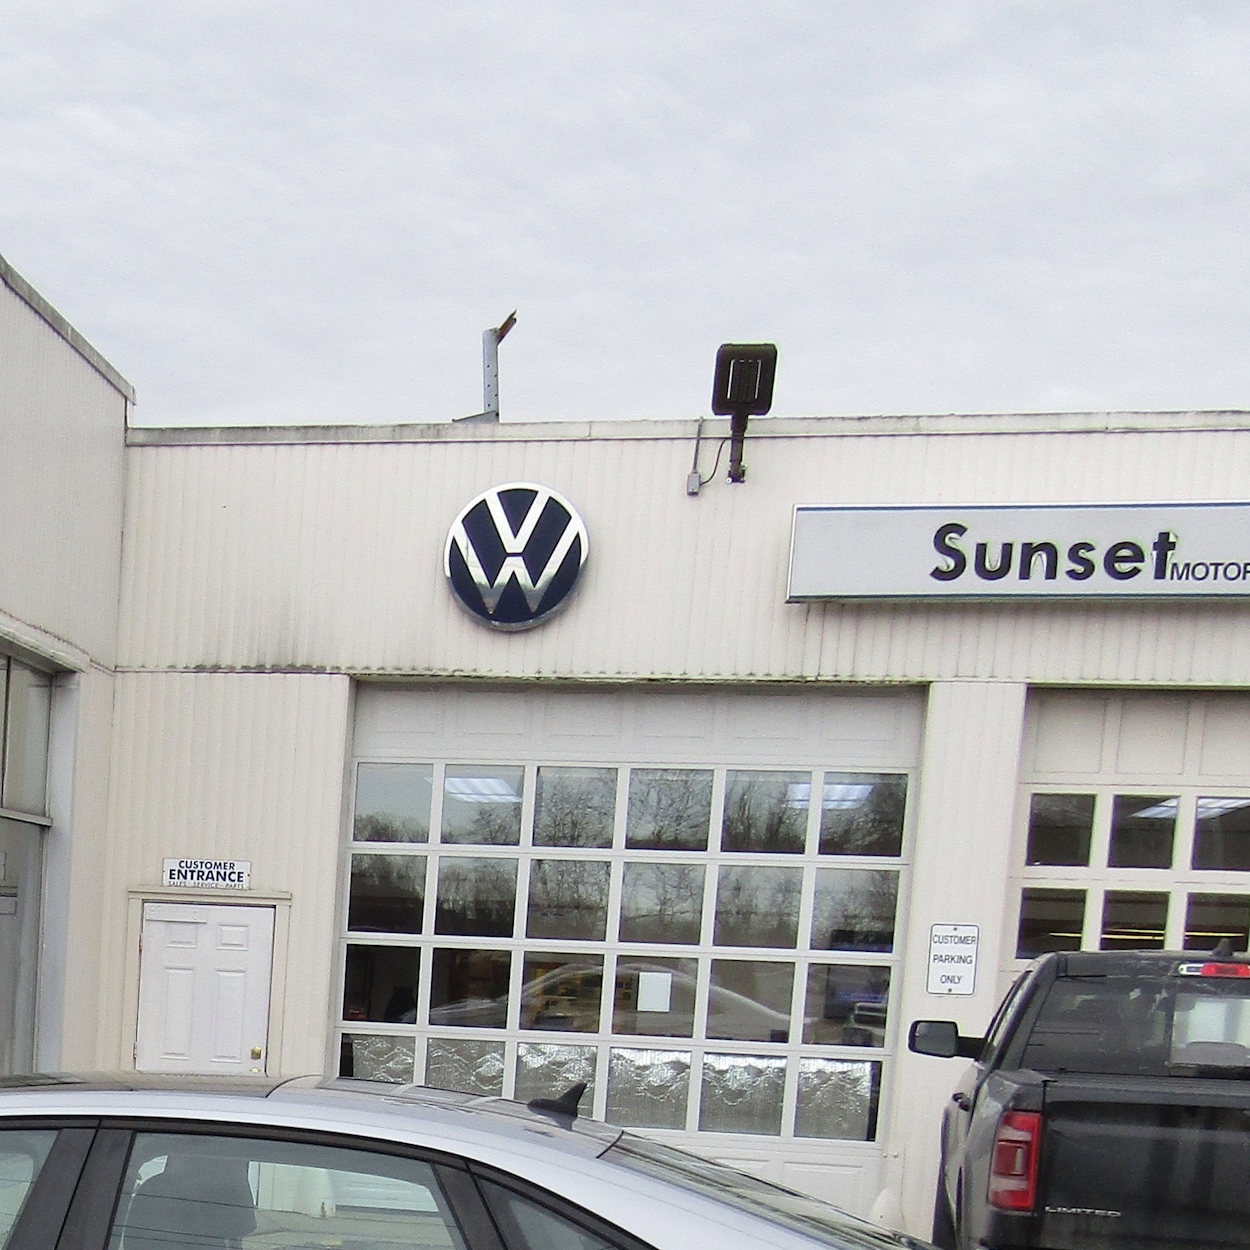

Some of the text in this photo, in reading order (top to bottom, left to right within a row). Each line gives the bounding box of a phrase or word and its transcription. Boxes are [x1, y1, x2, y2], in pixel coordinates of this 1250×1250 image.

[930, 522, 1176, 581] Sunset
[178, 860, 235, 871] CUSTOMER
[168, 869, 244, 883] ENTRANCE
[932, 934, 977, 945] CUSTOMER
[932, 954, 973, 965] PARKING
[940, 974, 963, 985] ONLY
[1044, 1206, 1121, 1218] LIMITED
